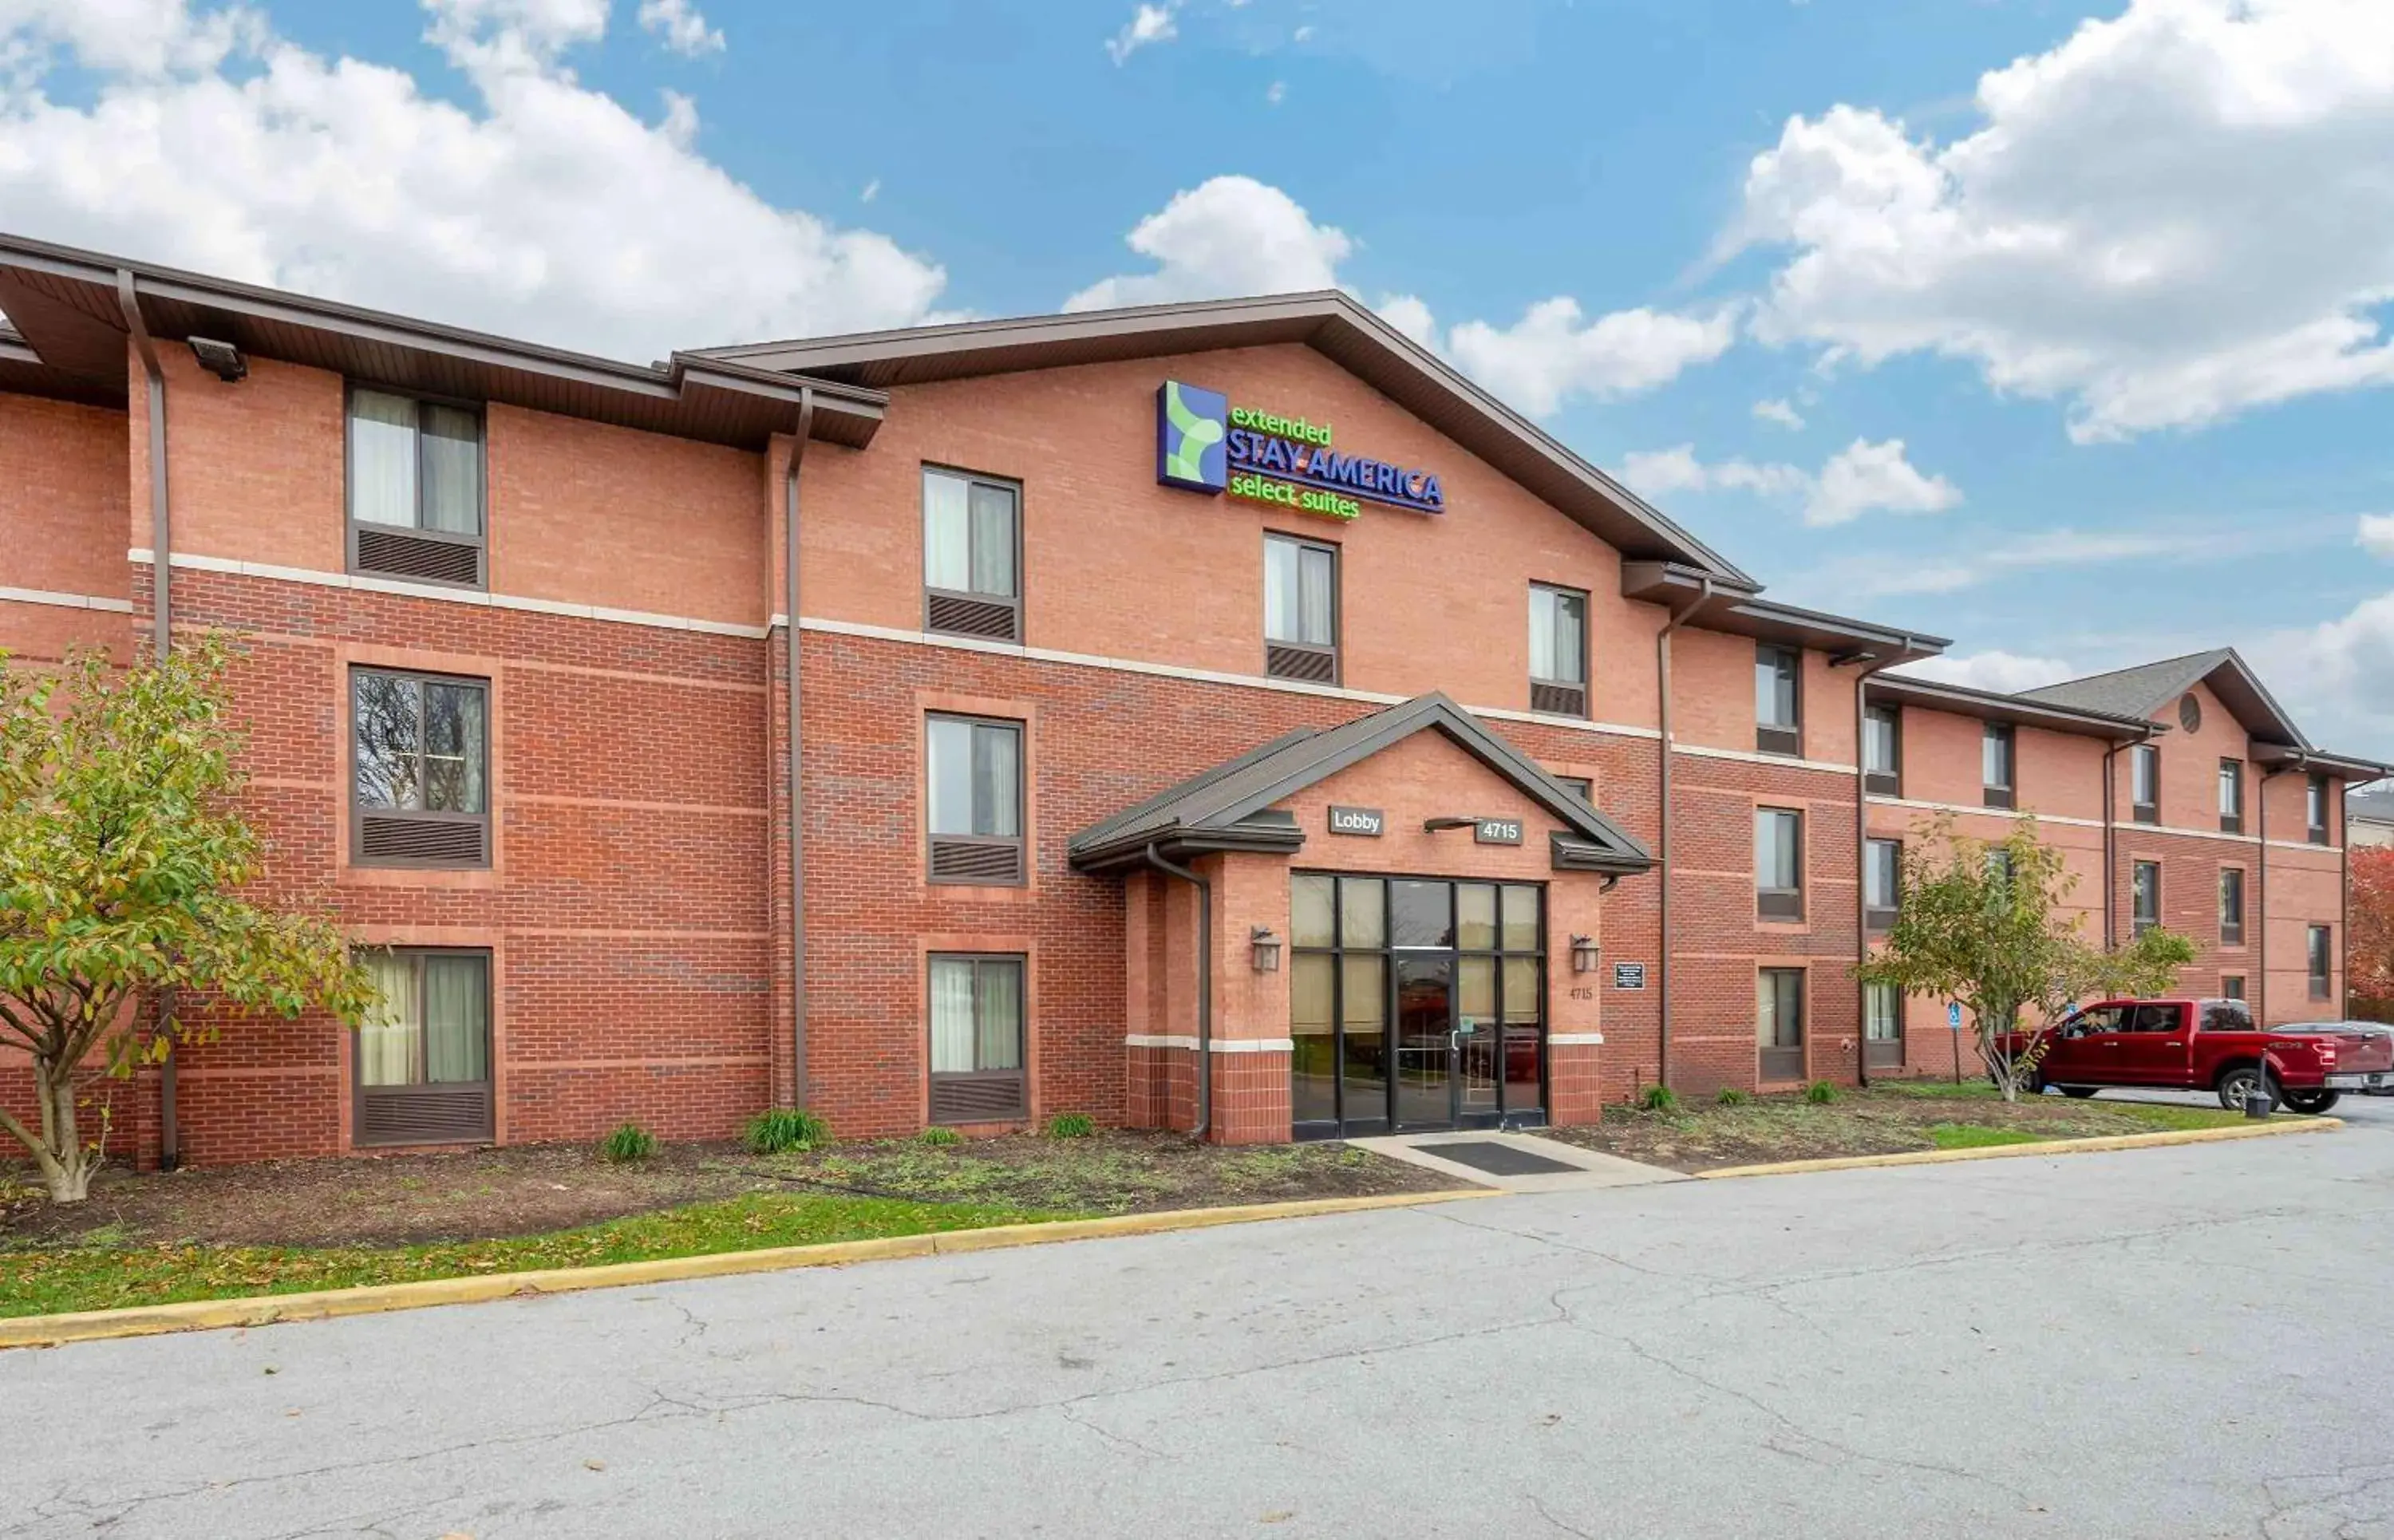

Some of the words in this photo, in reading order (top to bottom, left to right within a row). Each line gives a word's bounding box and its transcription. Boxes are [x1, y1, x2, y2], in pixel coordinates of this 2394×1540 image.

[1230, 405, 1332, 447] extended
[1227, 428, 1305, 472] STAY
[1308, 446, 1446, 505] AMERICA
[1231, 475, 1295, 506] select
[1302, 491, 1360, 520] suites
[1334, 811, 1380, 832] Lobby
[1483, 823, 1518, 839] 4715
[1570, 987, 1593, 1001] 4715
